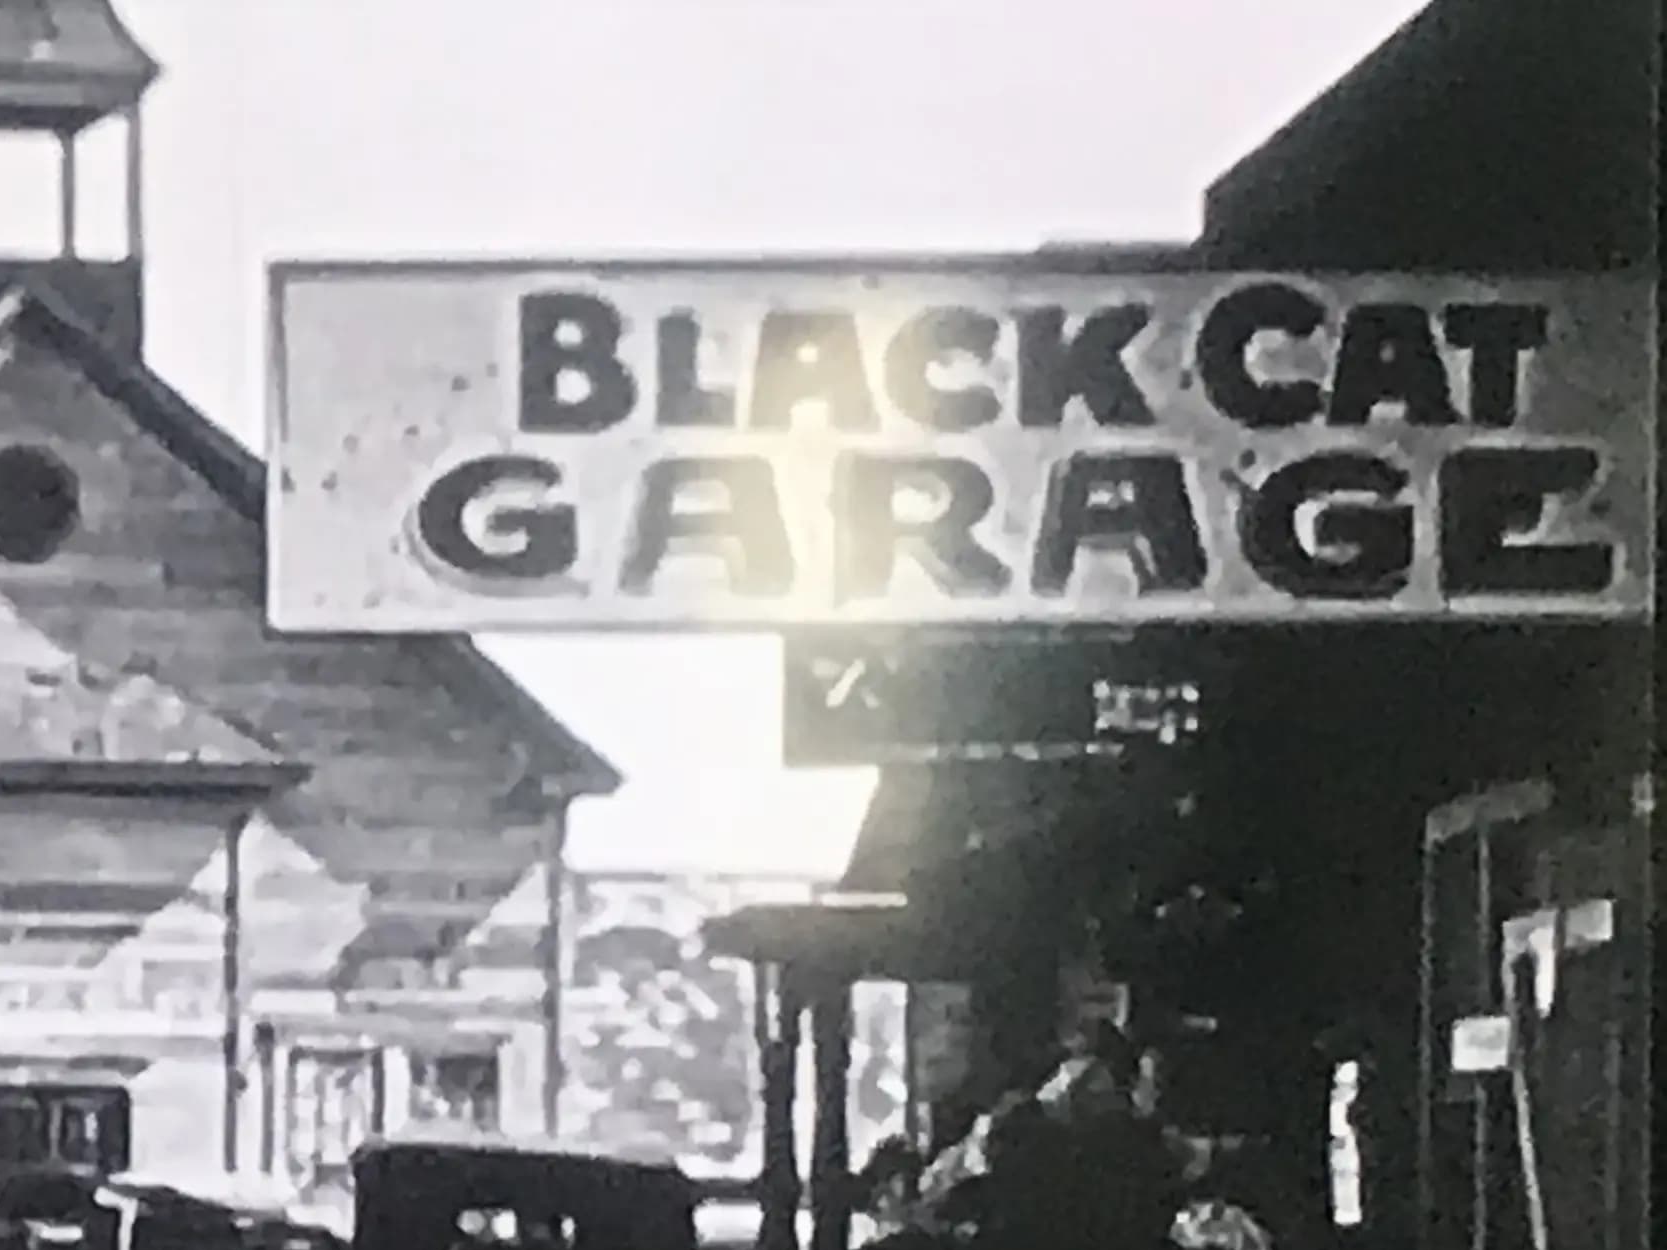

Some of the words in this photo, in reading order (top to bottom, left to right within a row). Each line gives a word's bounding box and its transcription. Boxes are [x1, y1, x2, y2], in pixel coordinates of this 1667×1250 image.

[518, 293, 1156, 430] BLACK
[1196, 285, 1549, 428] CAT
[414, 448, 1616, 598] GARAGE
